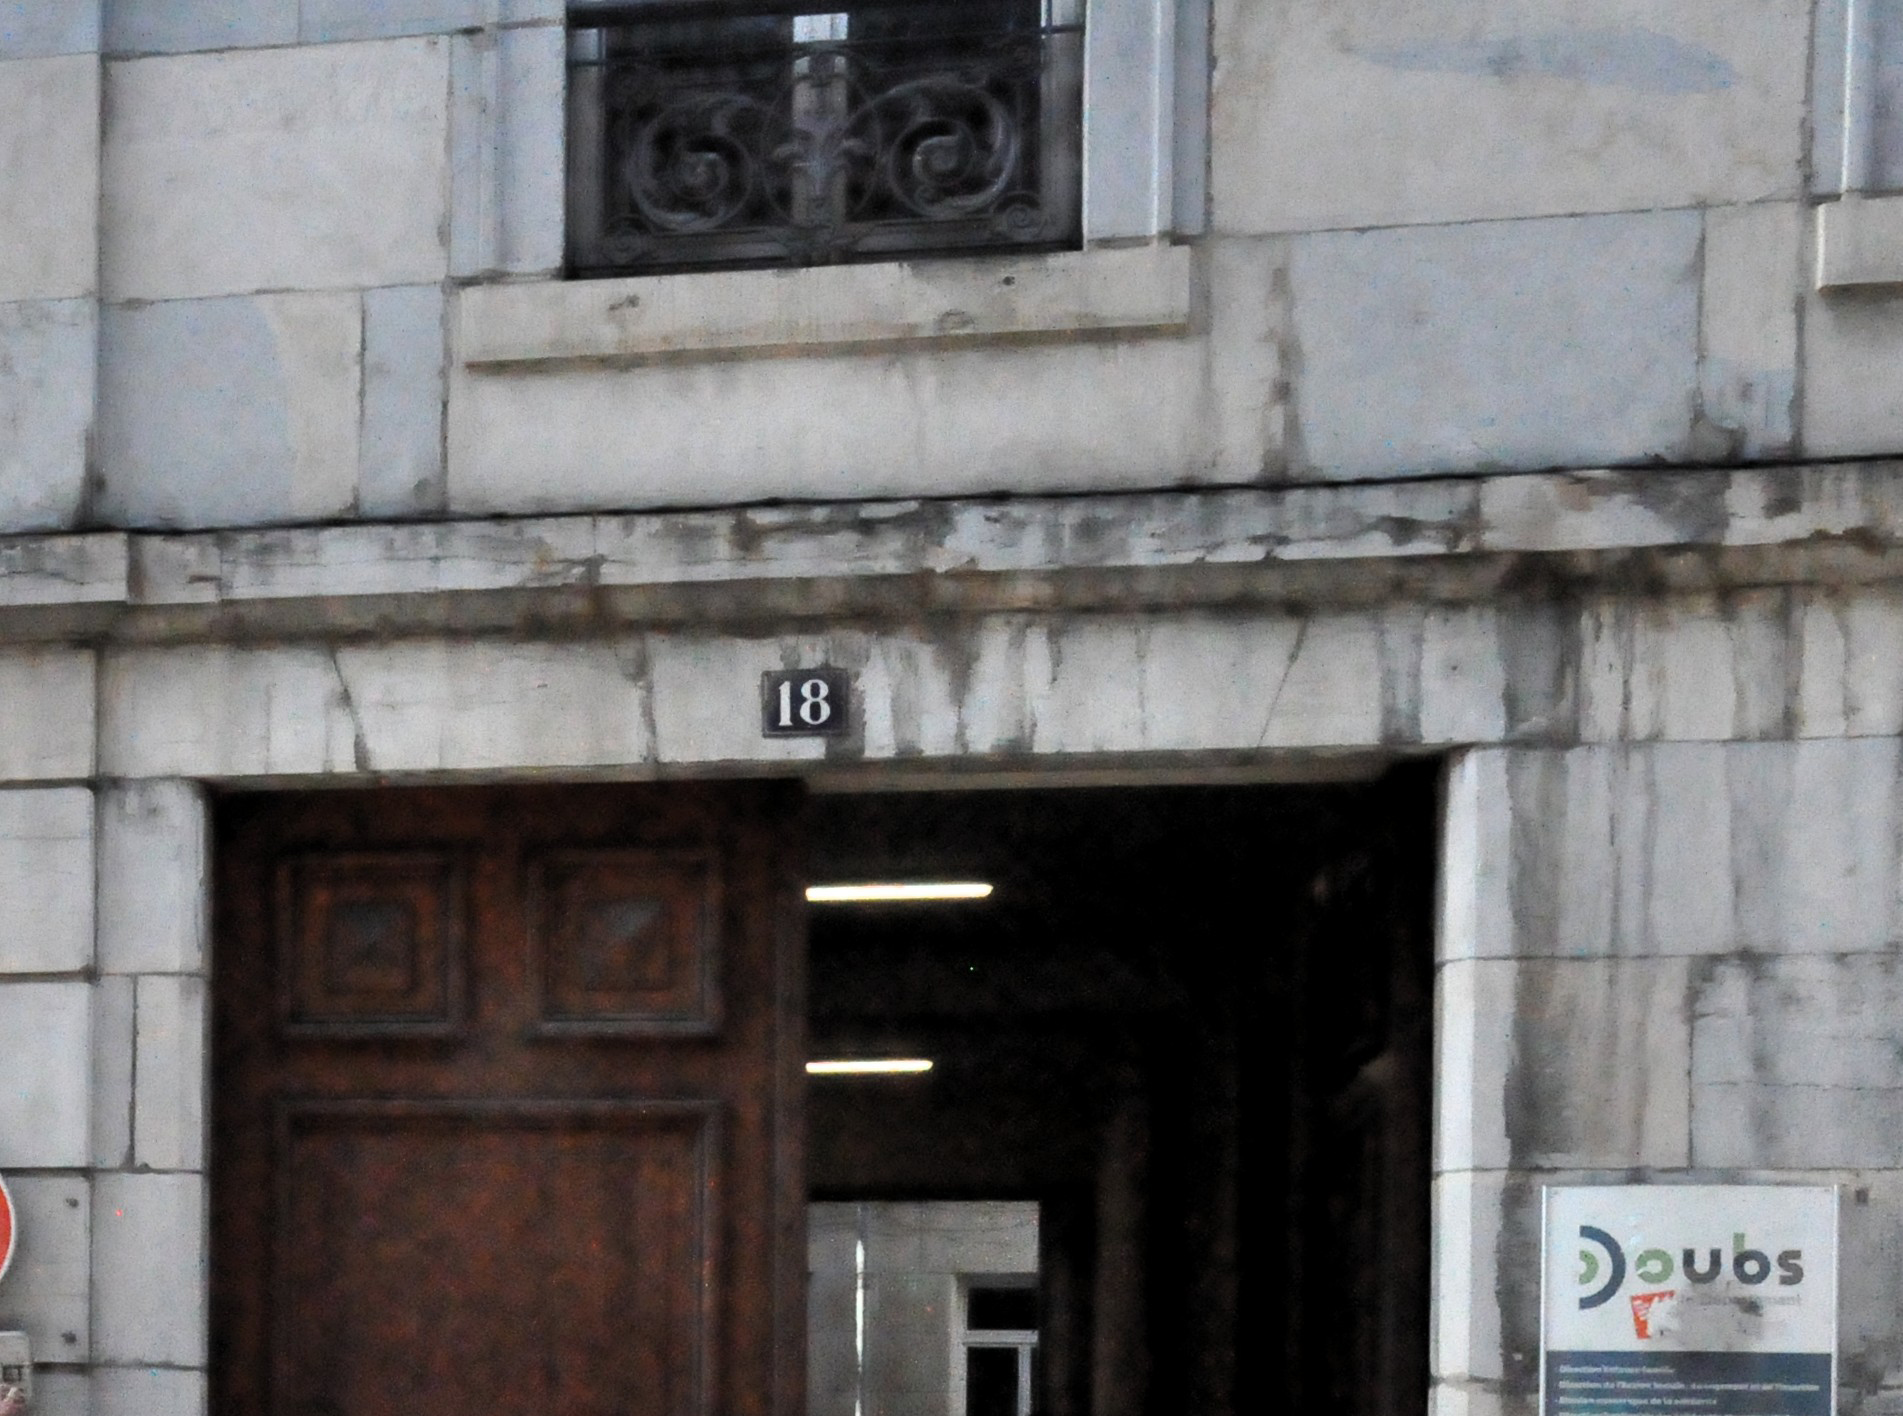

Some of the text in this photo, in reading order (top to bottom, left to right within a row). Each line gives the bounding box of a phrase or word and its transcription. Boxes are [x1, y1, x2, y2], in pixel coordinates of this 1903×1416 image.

[779, 679, 831, 726] 18
[1578, 1225, 1806, 1310] Doubs
[2, 1364, 25, 1383] ET
